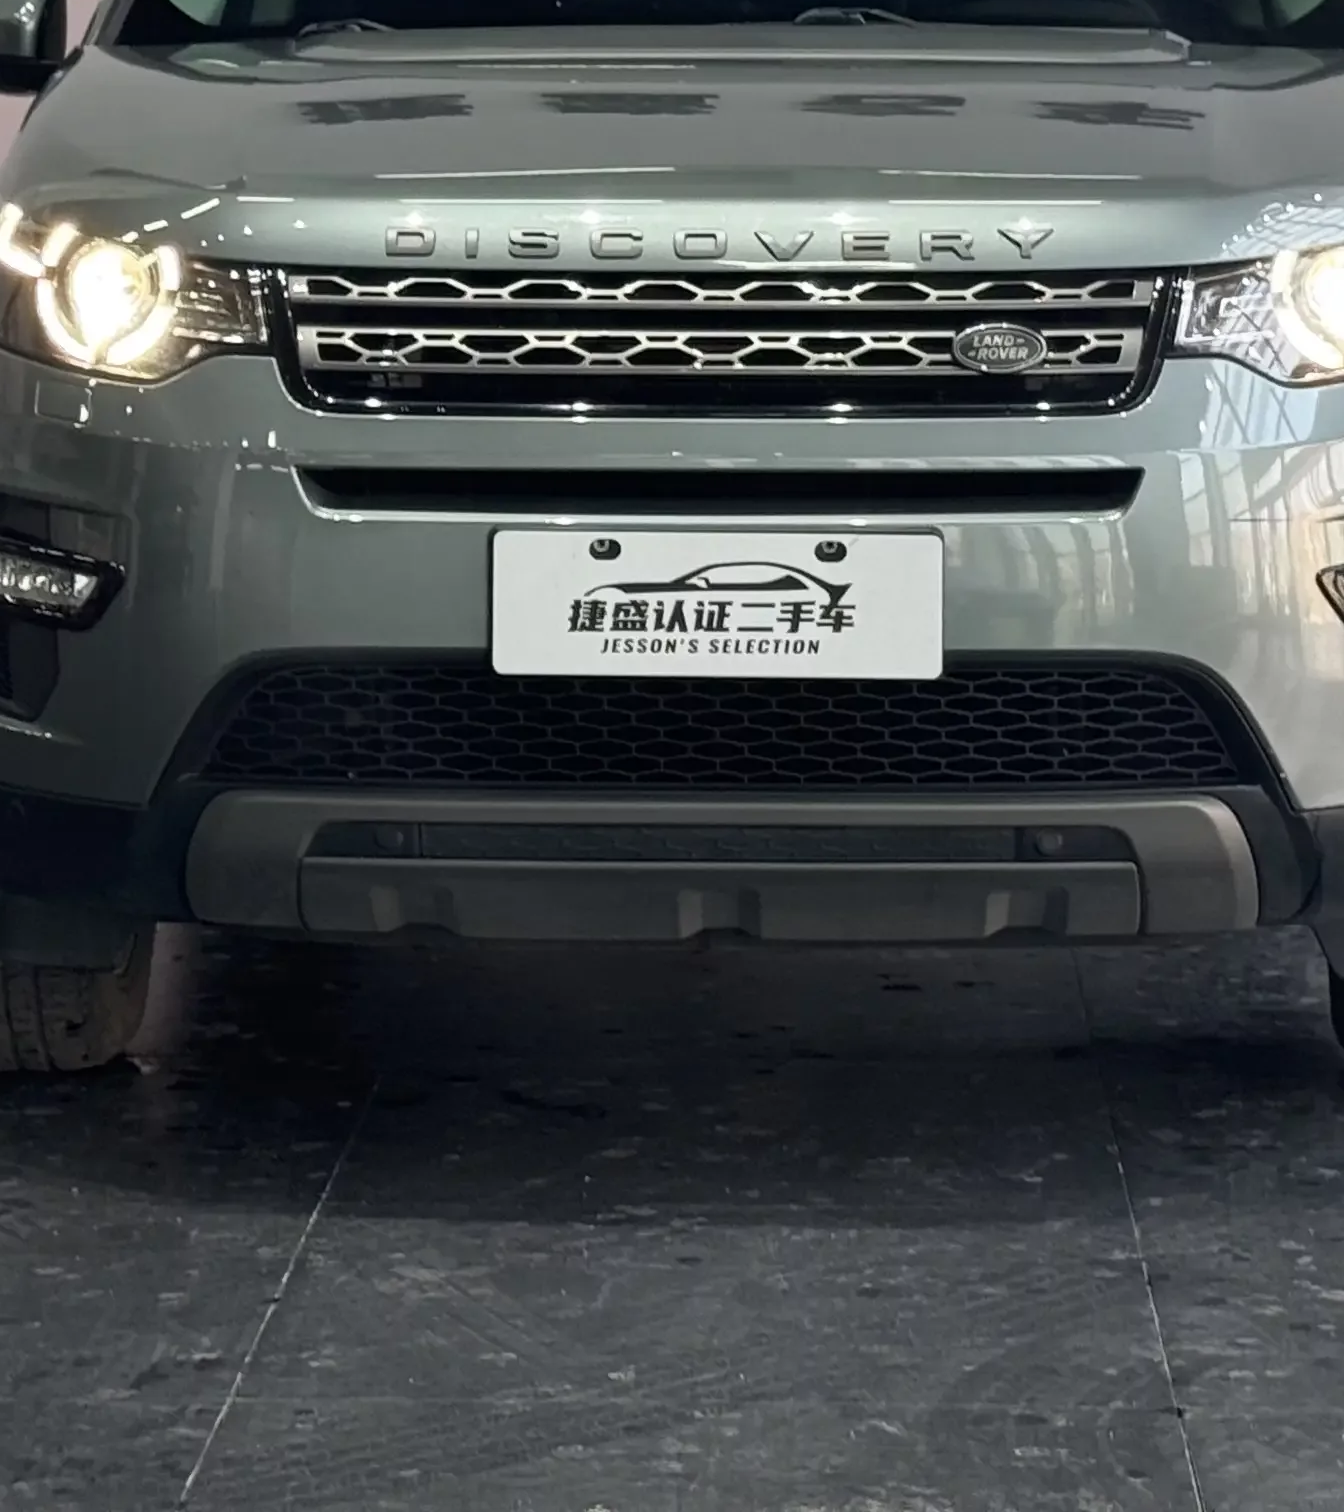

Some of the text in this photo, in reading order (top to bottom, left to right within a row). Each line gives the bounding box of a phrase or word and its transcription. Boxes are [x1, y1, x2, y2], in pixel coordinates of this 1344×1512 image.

[385, 226, 1056, 262] DISCOVERY
[568, 599, 856, 633] 捷盛认证二手车
[601, 638, 820, 655] JESSON'S SELECTION
